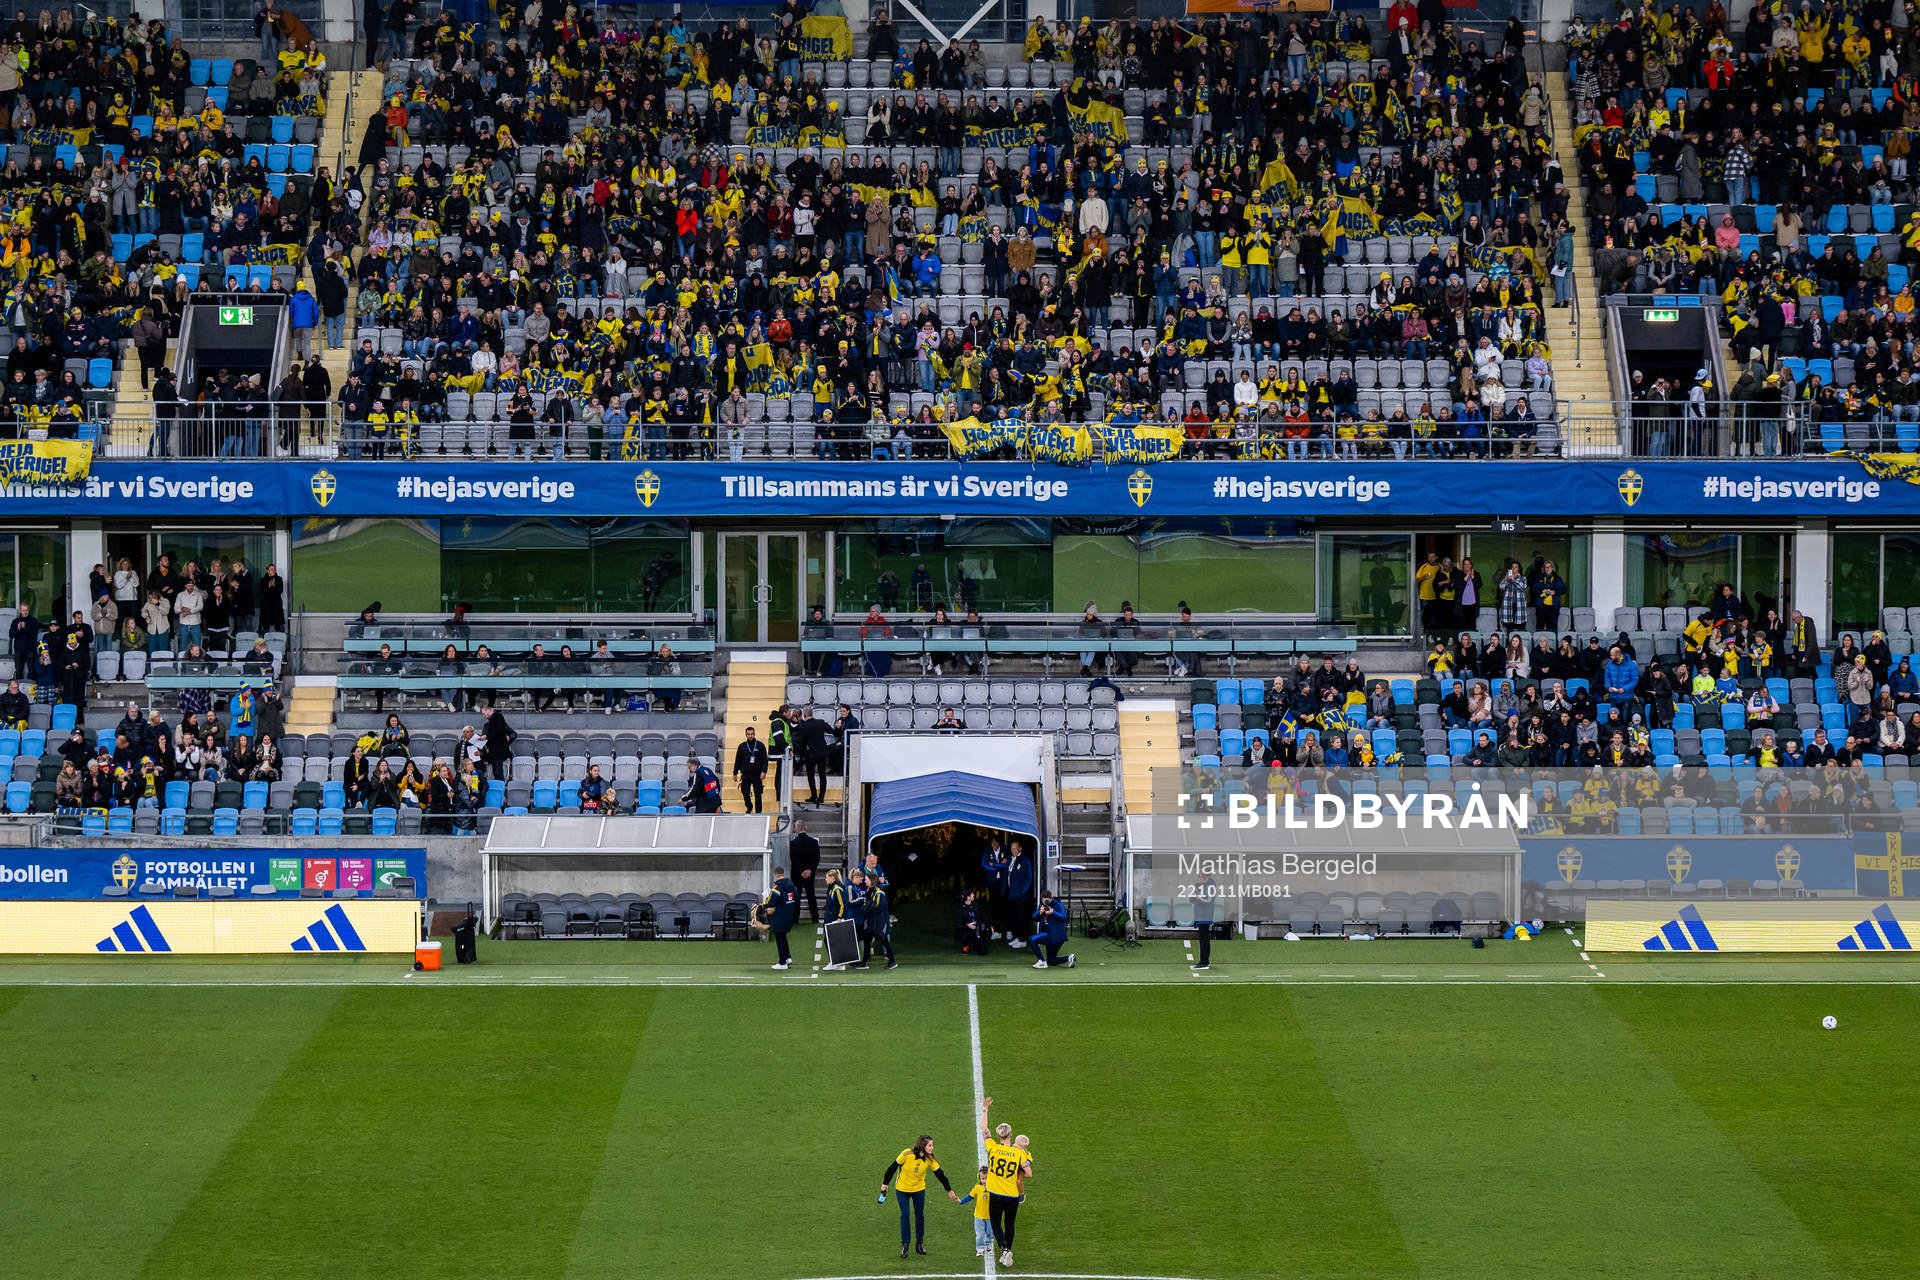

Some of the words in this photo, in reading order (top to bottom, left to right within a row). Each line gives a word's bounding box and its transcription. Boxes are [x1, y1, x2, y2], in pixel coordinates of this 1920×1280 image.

[85, 476, 113, 498] är
[119, 475, 144, 498] vi
[149, 476, 254, 502] Sverige
[397, 476, 575, 503] #hejasverige
[720, 475, 896, 498] Tillsammans
[900, 475, 930, 498] är
[934, 475, 960, 498] vi
[963, 475, 1068, 501] Sverige
[1213, 475, 1391, 503] #hejasverige
[1703, 476, 1880, 502] #hejasverige
[1501, 523, 1515, 531] M5
[145, 861, 245, 875] FOTBOLLEN
[250, 861, 255, 875] I
[272, 860, 277, 869] 3
[307, 860, 312, 868] 5
[342, 860, 349, 869] 10
[376, 860, 384, 869] 13
[1865, 857, 1881, 868] VI
[1888, 832, 1900, 896] SKAPAR
[990, 1155, 1018, 1178] 189
